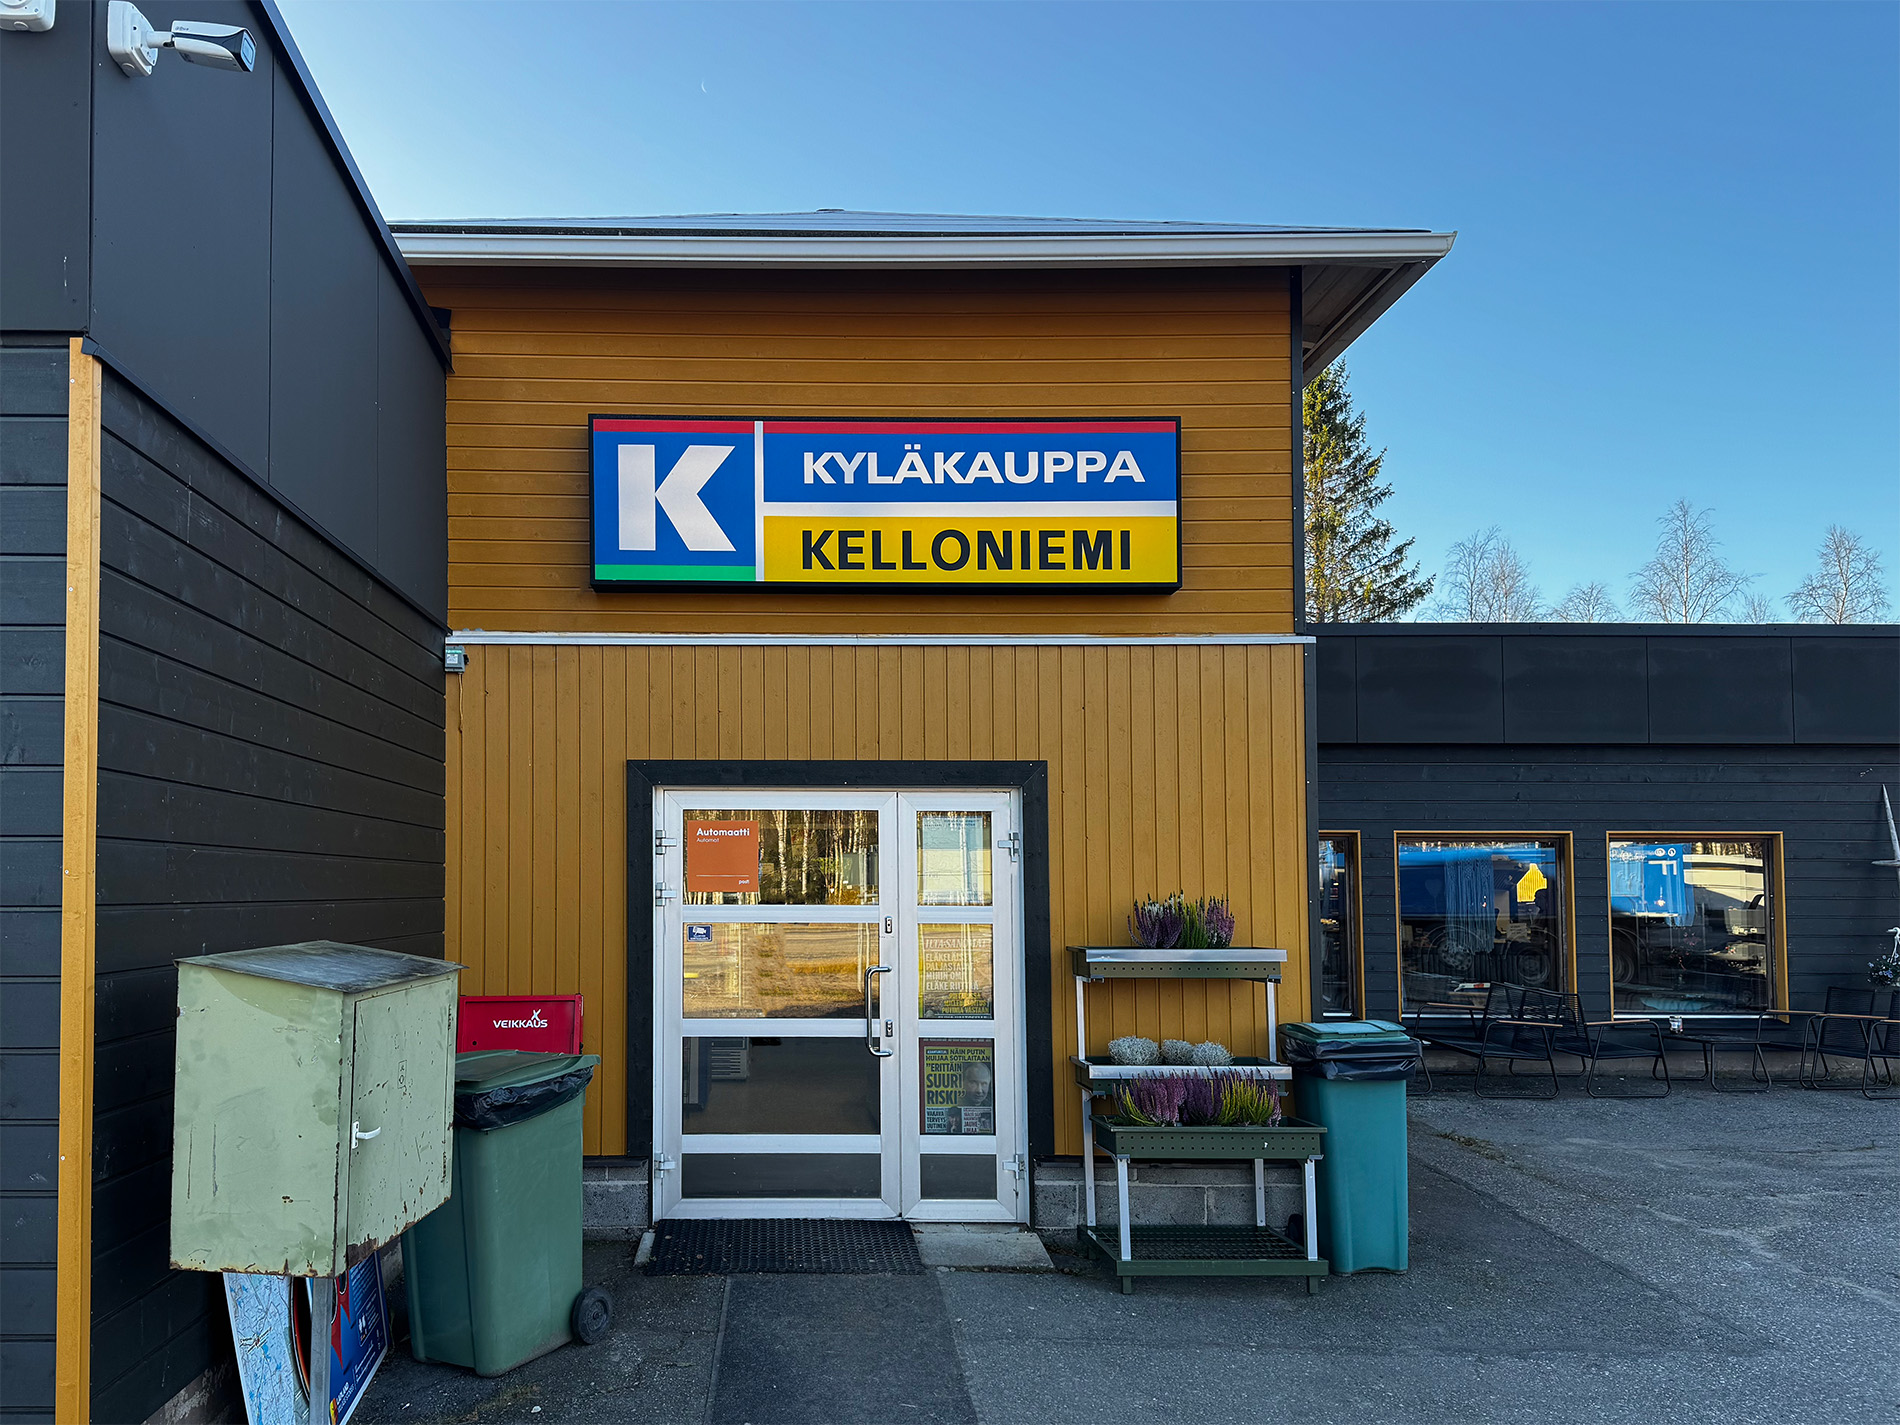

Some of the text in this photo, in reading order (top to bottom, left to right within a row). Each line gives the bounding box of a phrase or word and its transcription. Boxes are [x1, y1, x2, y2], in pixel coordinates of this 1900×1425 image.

[803, 443, 1146, 485] KYLÄKAUPPA
[618, 444, 737, 552] K
[801, 528, 1132, 572] KELLONIEMI
[696, 827, 750, 836] Automaatti
[926, 980, 949, 991] ELÄKE
[492, 1018, 549, 1029] VEIKKAUS
[926, 1073, 963, 1088] SUURI
